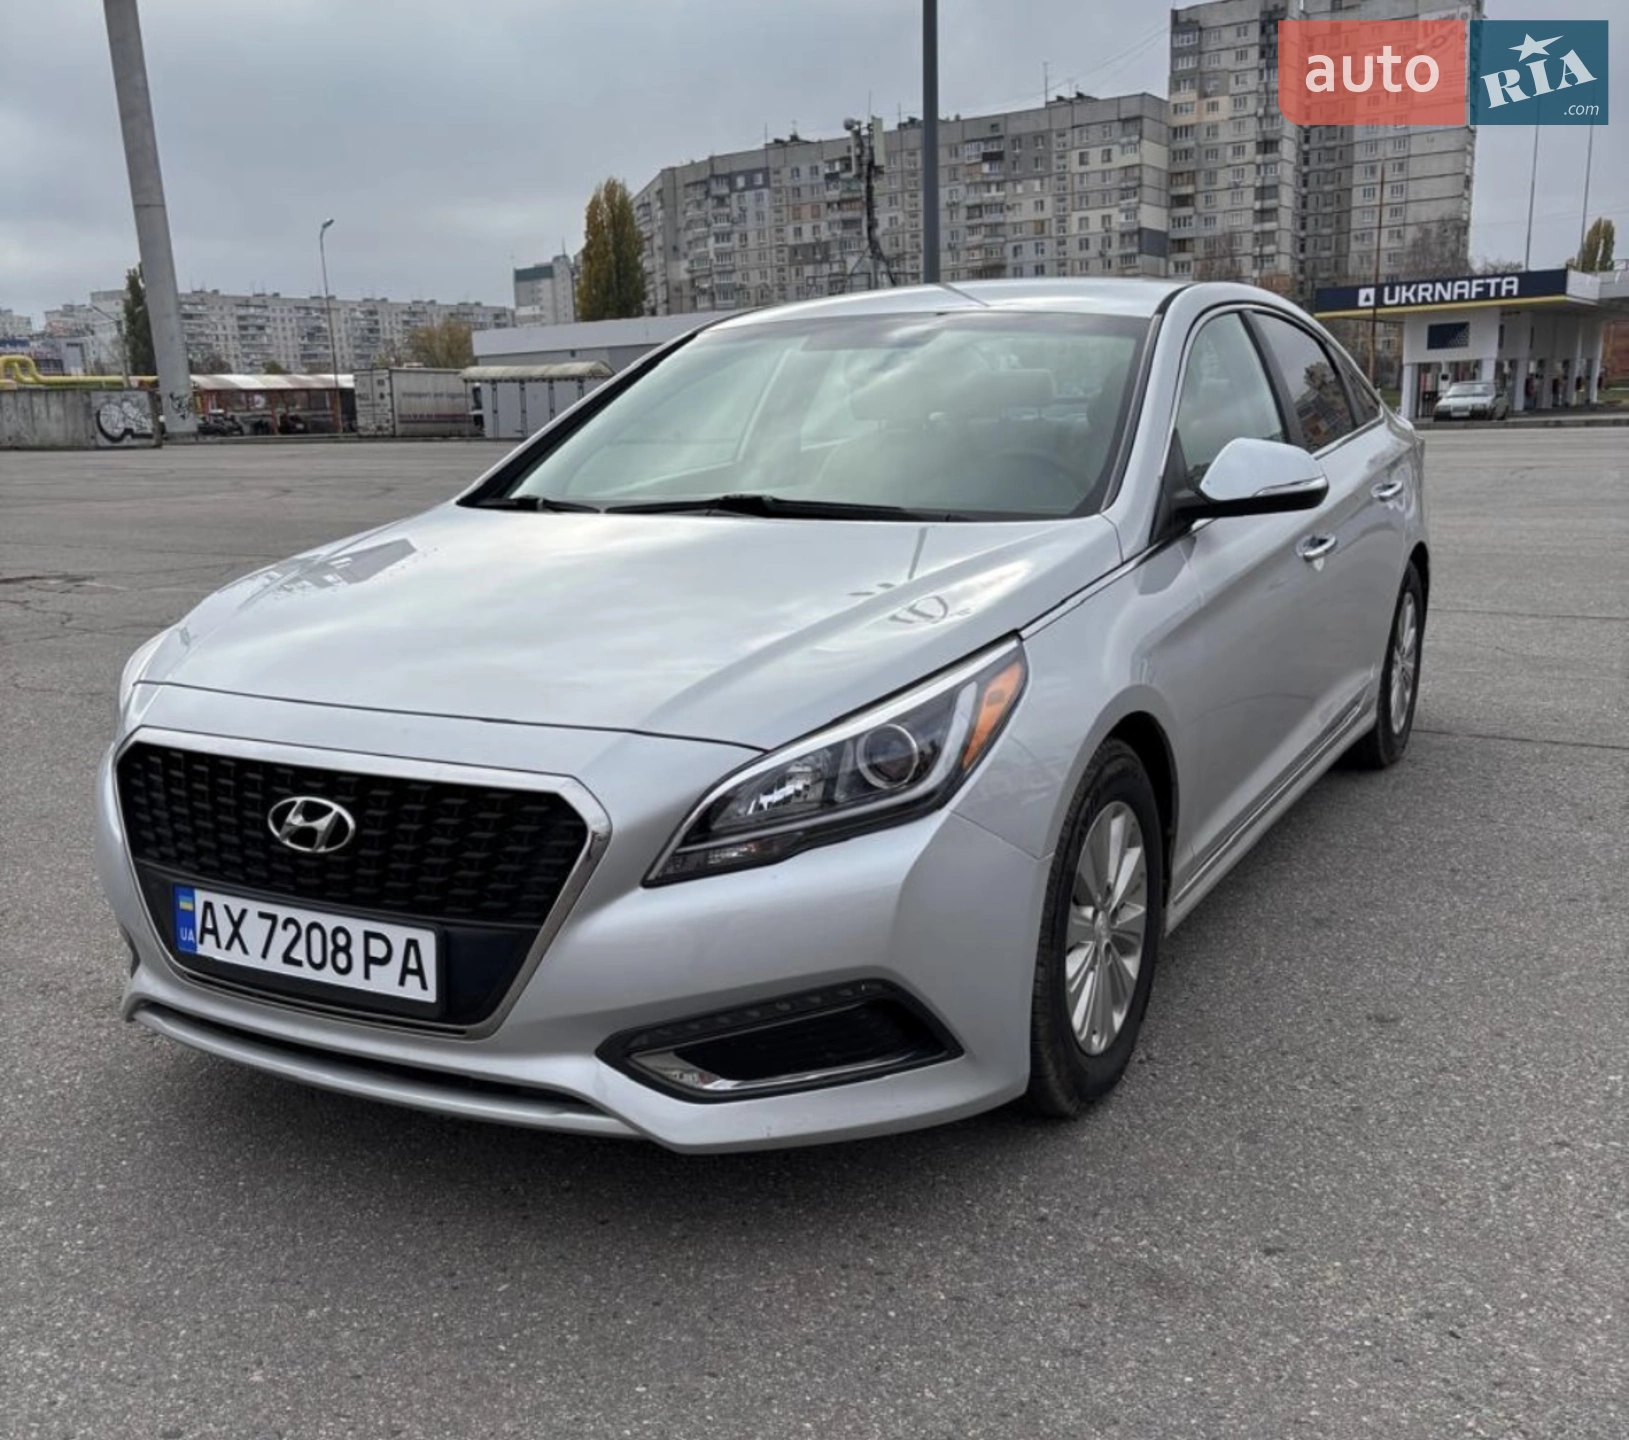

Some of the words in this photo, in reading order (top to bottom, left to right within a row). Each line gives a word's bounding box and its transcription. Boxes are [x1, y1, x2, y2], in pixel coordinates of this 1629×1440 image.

[1383, 276, 1519, 305] UKRNAFTA
[180, 927, 196, 943] UA
[198, 901, 249, 955] AX
[257, 911, 353, 975] 7208
[363, 930, 428, 990] PA
